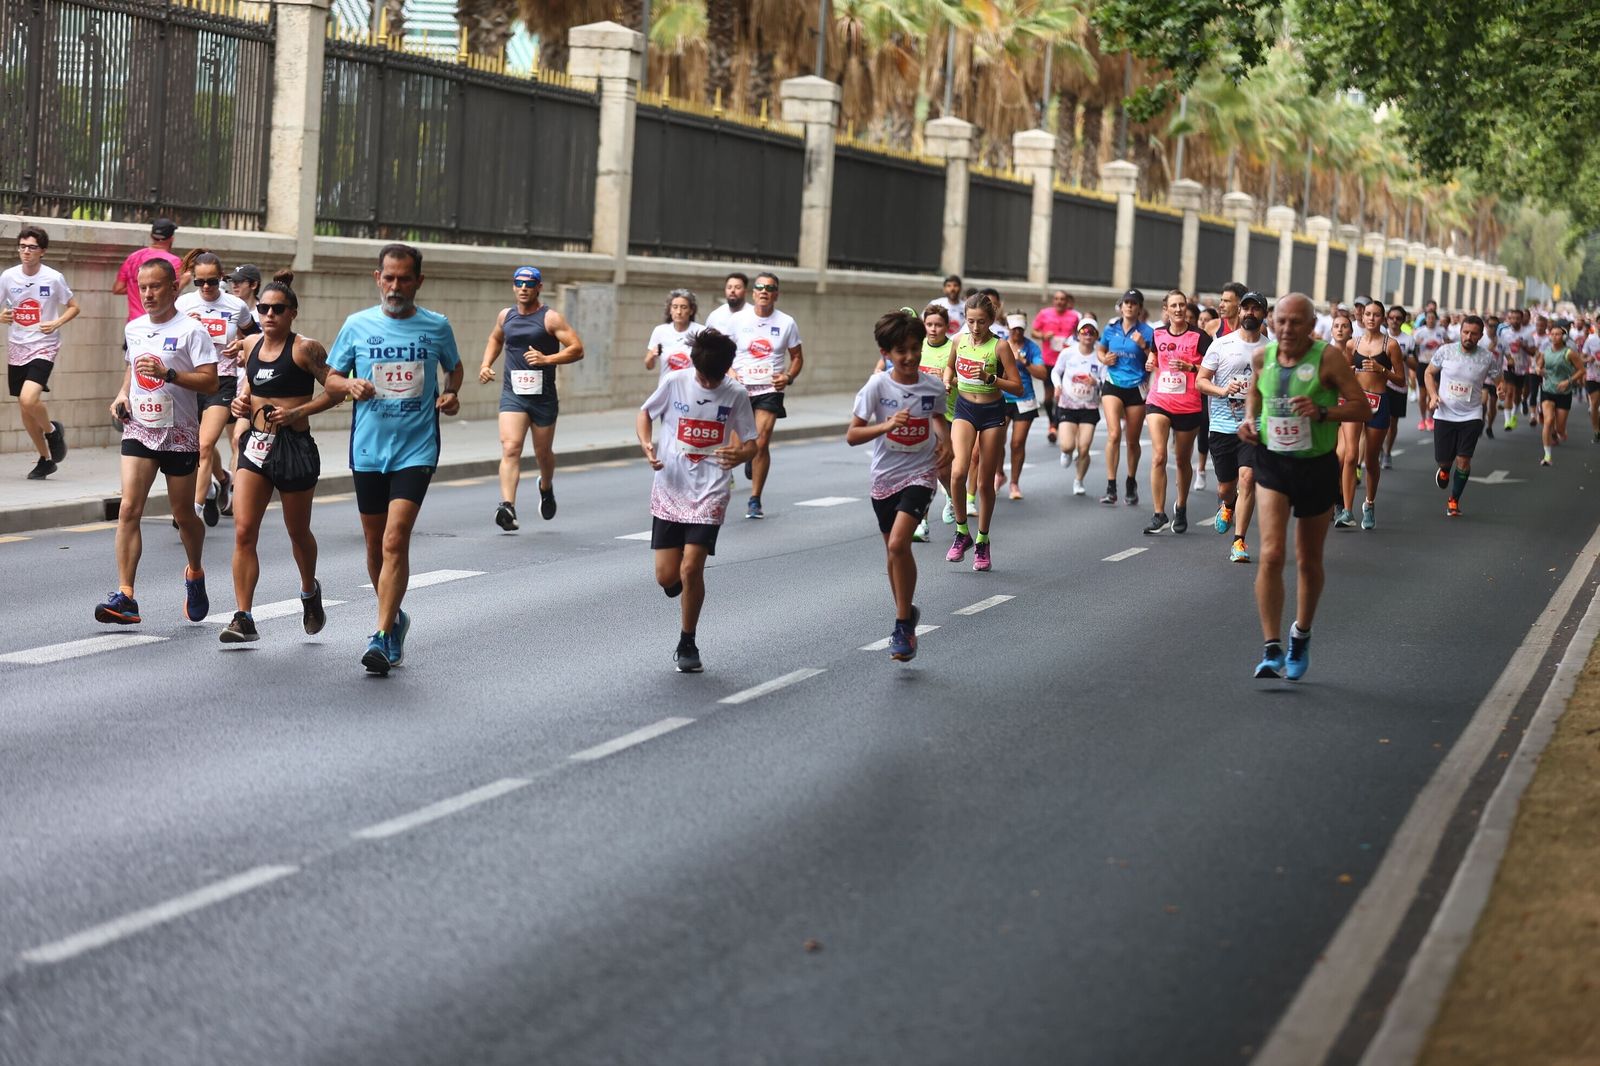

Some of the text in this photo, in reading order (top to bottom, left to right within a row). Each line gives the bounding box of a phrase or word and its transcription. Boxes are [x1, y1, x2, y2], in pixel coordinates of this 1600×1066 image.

[369, 342, 428, 362] nerja
[256, 368, 275, 379] NIKE
[386, 371, 414, 382] 716
[140, 404, 162, 412] 638
[684, 426, 719, 438] 2058
[892, 426, 926, 436] 2328
[1275, 426, 1299, 435] 615
